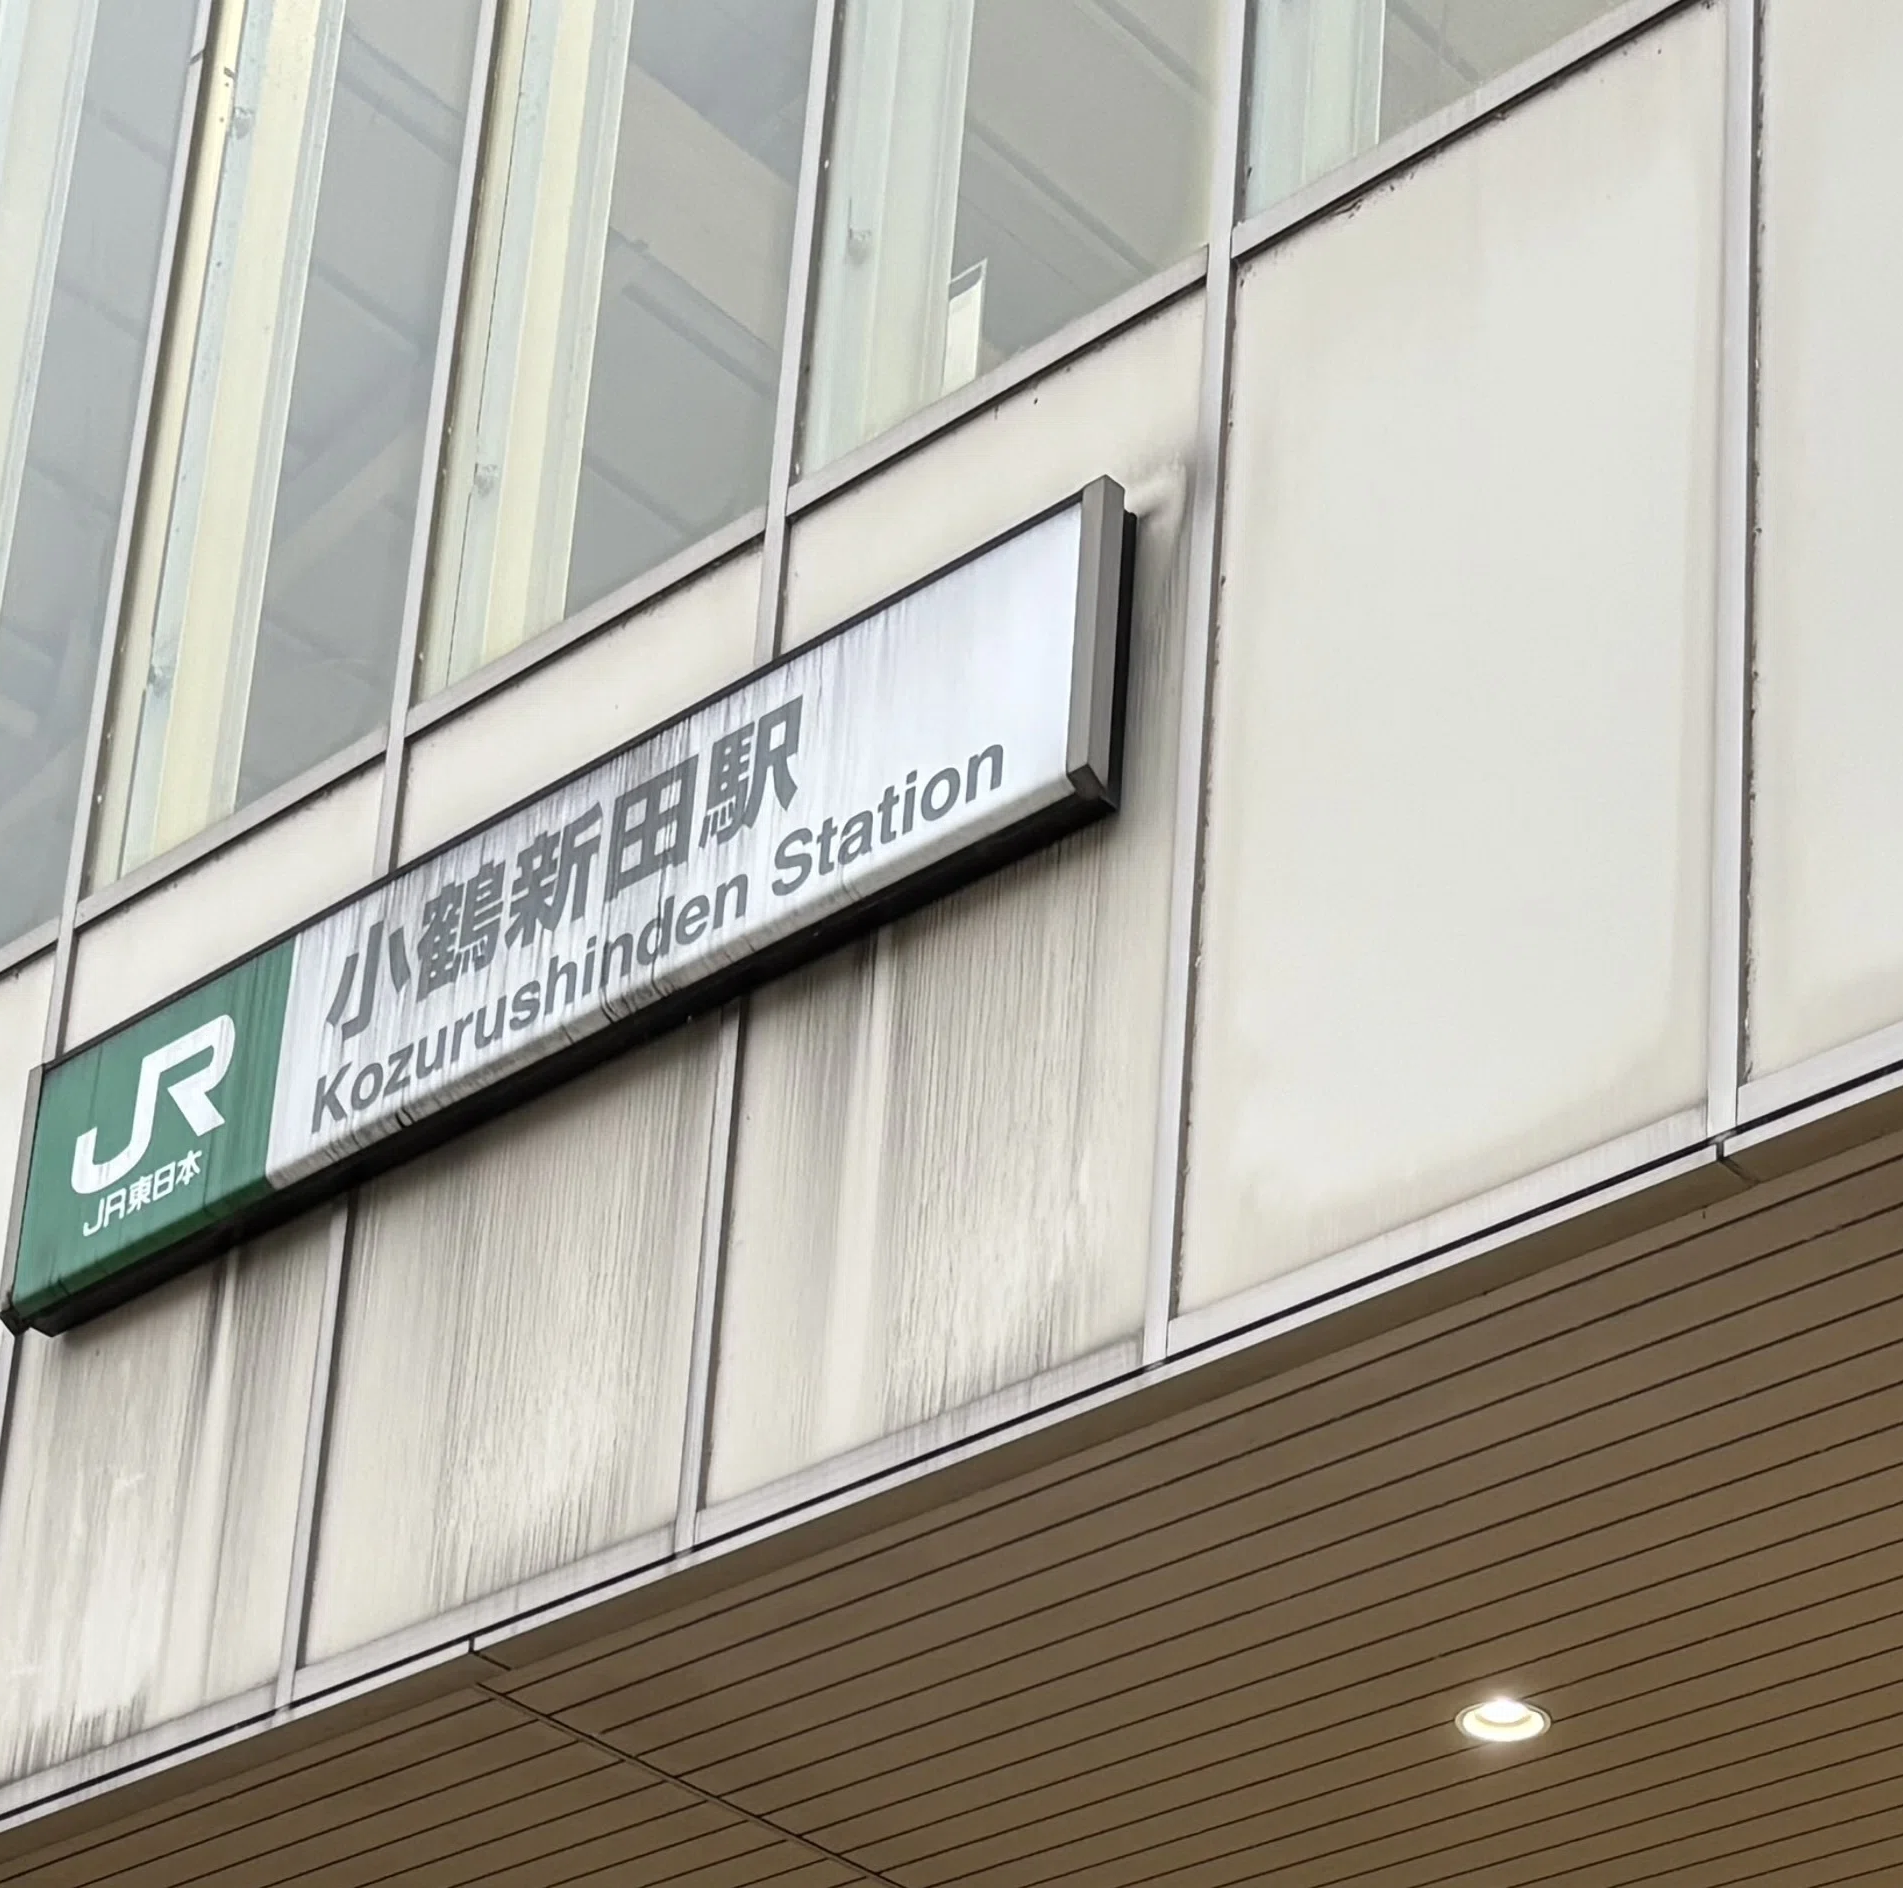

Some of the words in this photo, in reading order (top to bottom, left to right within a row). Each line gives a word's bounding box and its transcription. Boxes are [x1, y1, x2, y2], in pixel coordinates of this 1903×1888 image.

[309, 872, 748, 1133] Kozurushinden
[772, 743, 1004, 897] Station
[325, 694, 803, 1041] 小鶴新田駅
[70, 1013, 236, 1195] JR
[82, 1149, 203, 1237] JR東日本
